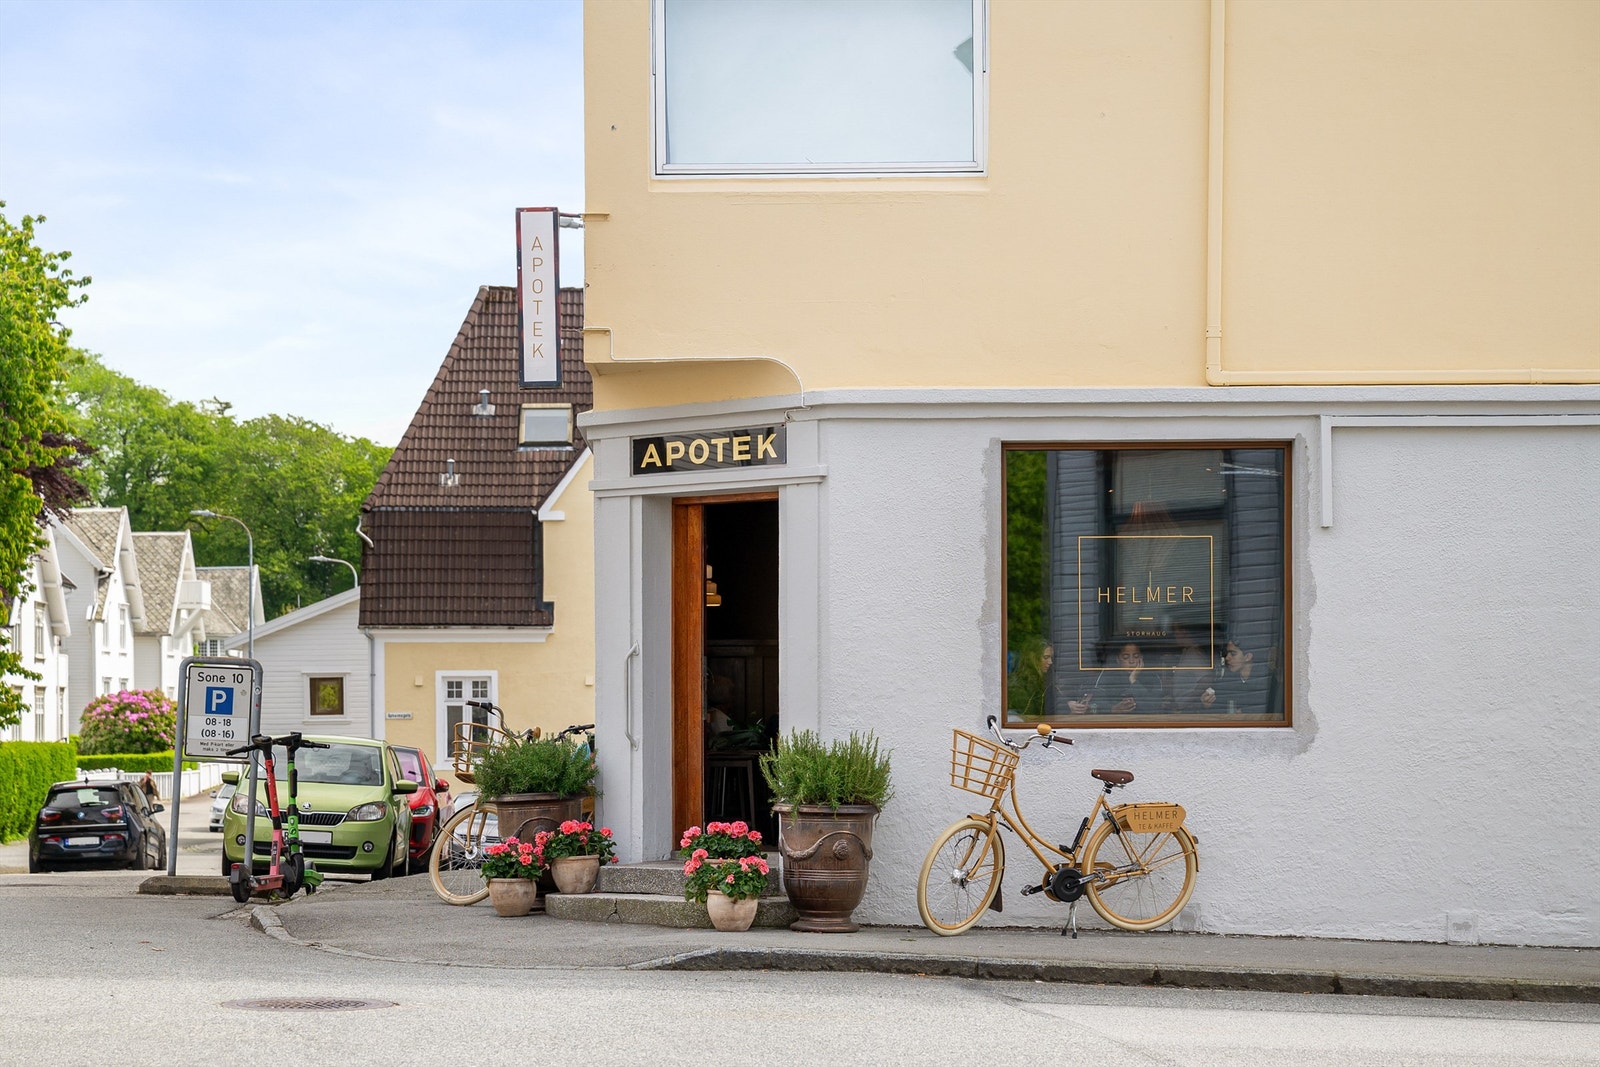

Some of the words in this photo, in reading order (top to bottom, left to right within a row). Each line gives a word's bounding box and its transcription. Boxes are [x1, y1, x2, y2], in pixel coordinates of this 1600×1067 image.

[531, 236, 544, 358] APOTEK
[640, 433, 778, 468] APOTEK
[1098, 586, 1194, 603] HELMER
[197, 671, 226, 683] Sone
[232, 673, 244, 684] 10
[211, 690, 227, 711] P
[1133, 810, 1178, 820] HELMER
